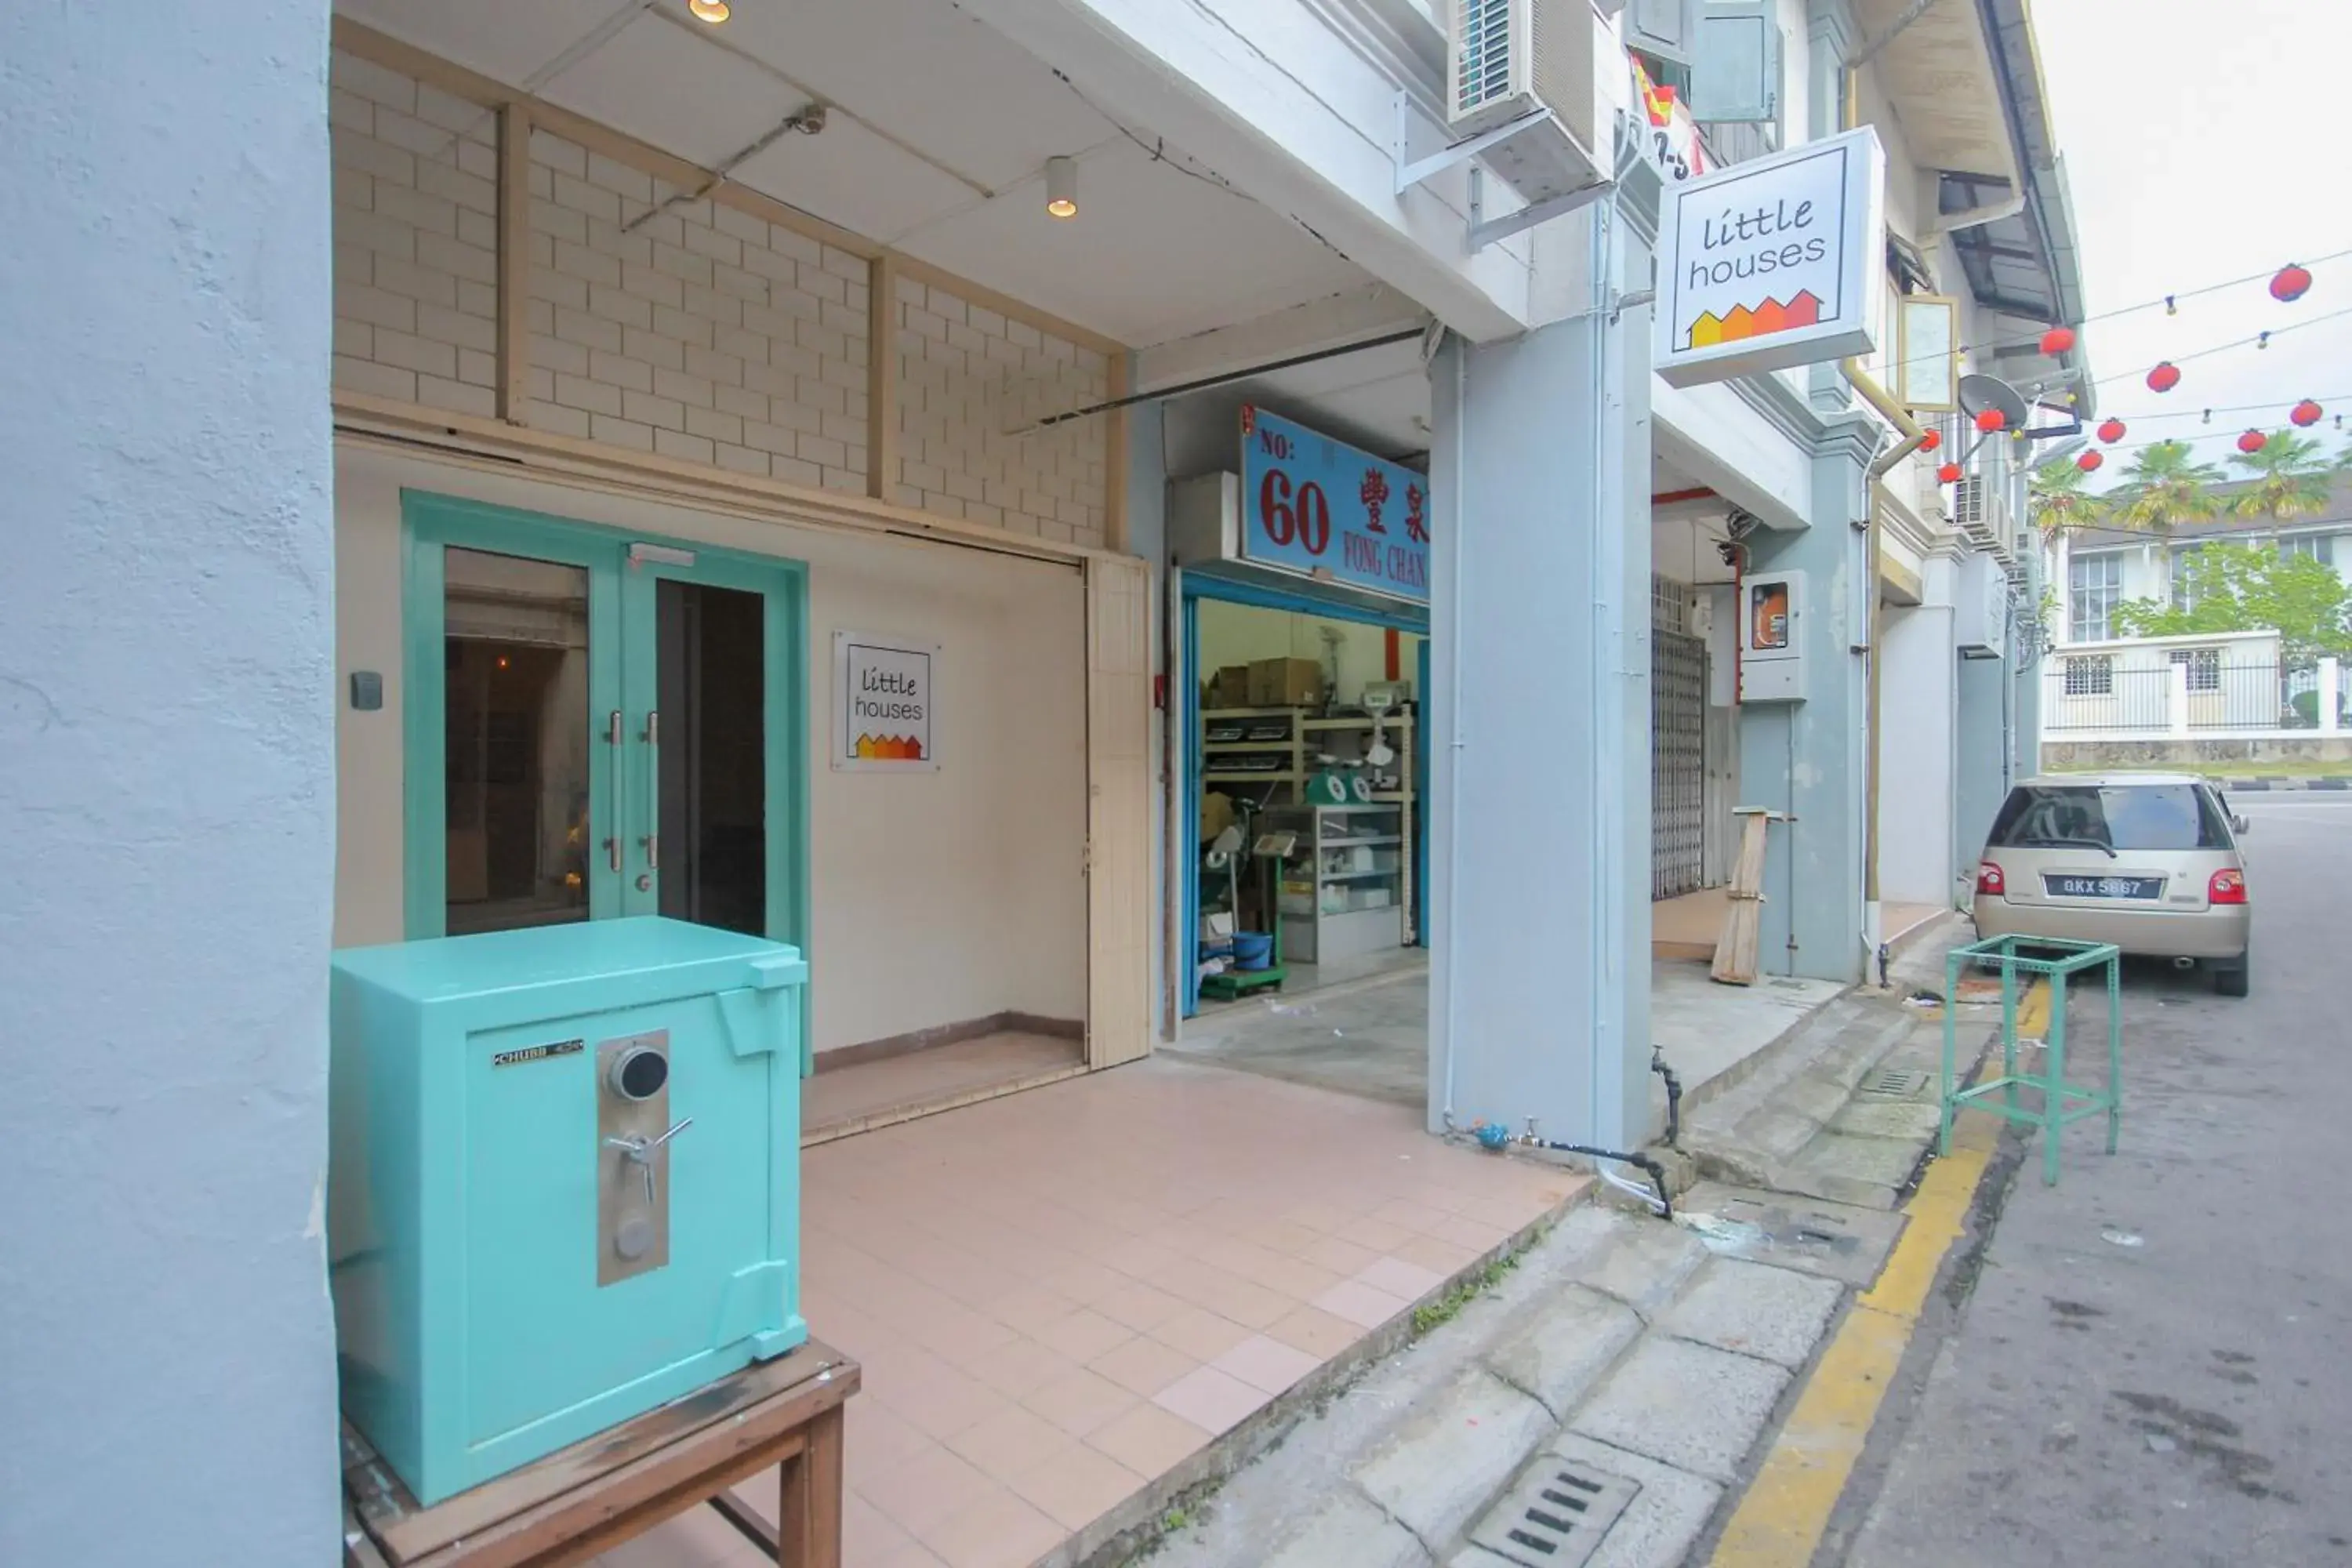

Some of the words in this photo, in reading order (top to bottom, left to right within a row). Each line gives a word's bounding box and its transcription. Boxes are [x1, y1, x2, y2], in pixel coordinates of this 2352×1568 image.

[1704, 200, 1814, 251] little
[1690, 238, 1825, 289] houses
[1261, 428, 1295, 459] NO:
[1261, 468, 1330, 556] 60
[1344, 531, 1381, 576] FONG
[862, 666, 916, 696] little
[855, 695, 923, 720] houses
[2063, 879, 2095, 893] QKX
